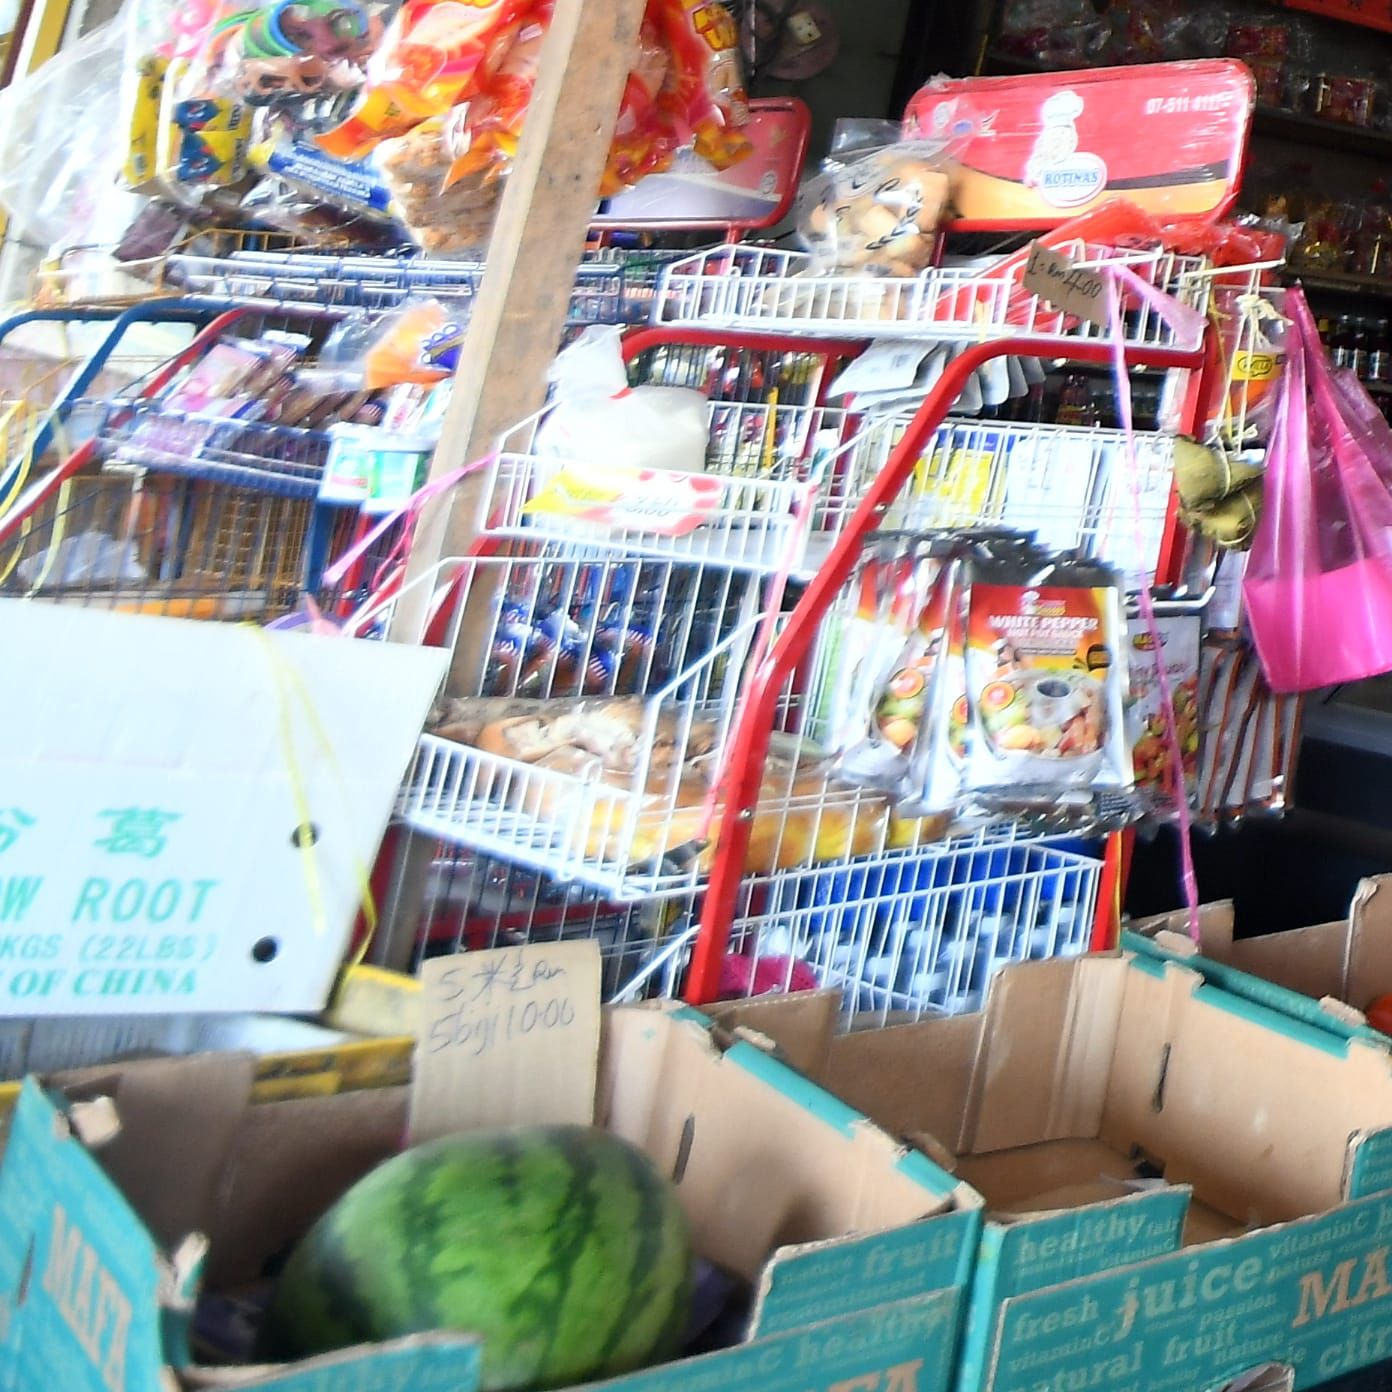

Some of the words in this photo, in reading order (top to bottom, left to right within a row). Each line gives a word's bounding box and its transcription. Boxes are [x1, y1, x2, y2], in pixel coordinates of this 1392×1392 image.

[989, 615, 1039, 629] WHITE
[1041, 616, 1098, 631] PEPPER
[73, 875, 221, 924] ROOT
[9, 968, 65, 996] OF
[72, 967, 197, 997] CHINA
[861, 1227, 960, 1282] fruit
[1016, 1212, 1148, 1266] healthy
[1269, 1209, 1370, 1260] vitaminC
[1012, 1293, 1100, 1343] fresh
[1114, 1257, 1264, 1343] juice
[1162, 1318, 1238, 1367] fruit
